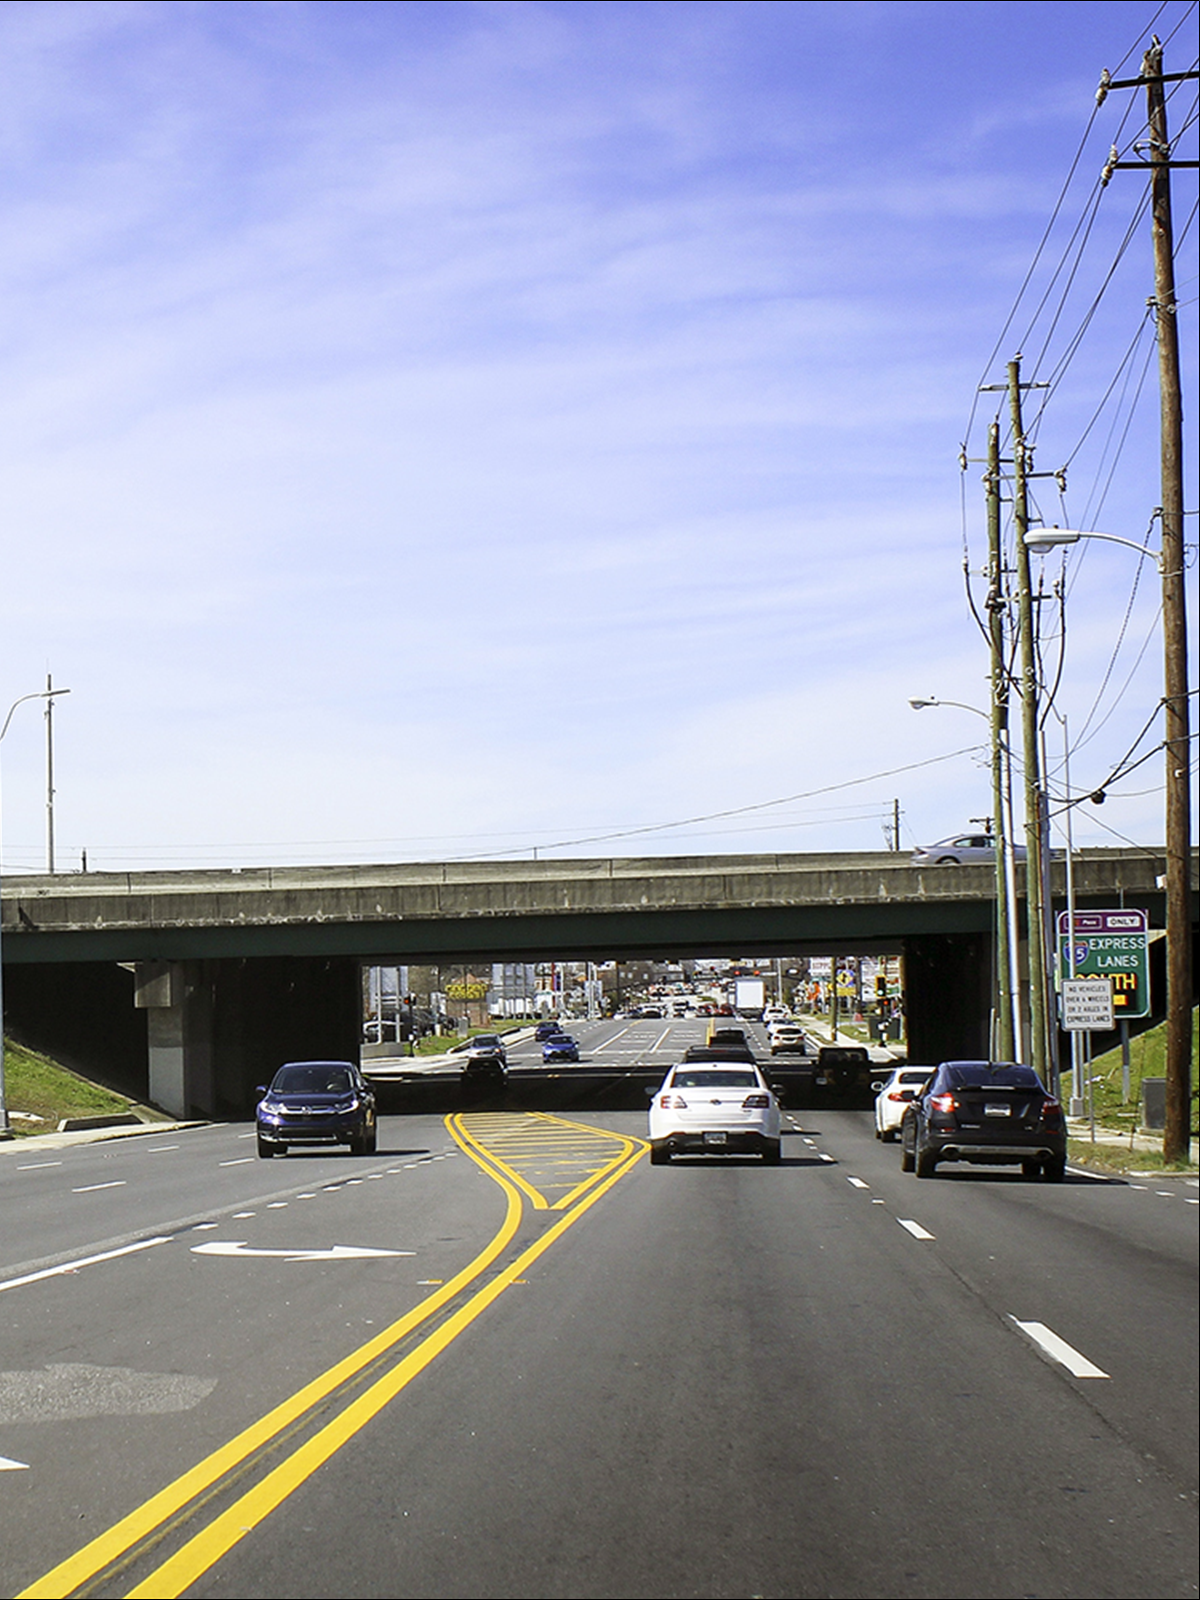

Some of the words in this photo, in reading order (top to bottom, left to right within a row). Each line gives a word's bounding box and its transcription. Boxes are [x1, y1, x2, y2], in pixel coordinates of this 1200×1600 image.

[1110, 917, 1137, 926] ONLY
[1089, 937, 1146, 950] EXPRESS
[1097, 955, 1139, 967] LANES
